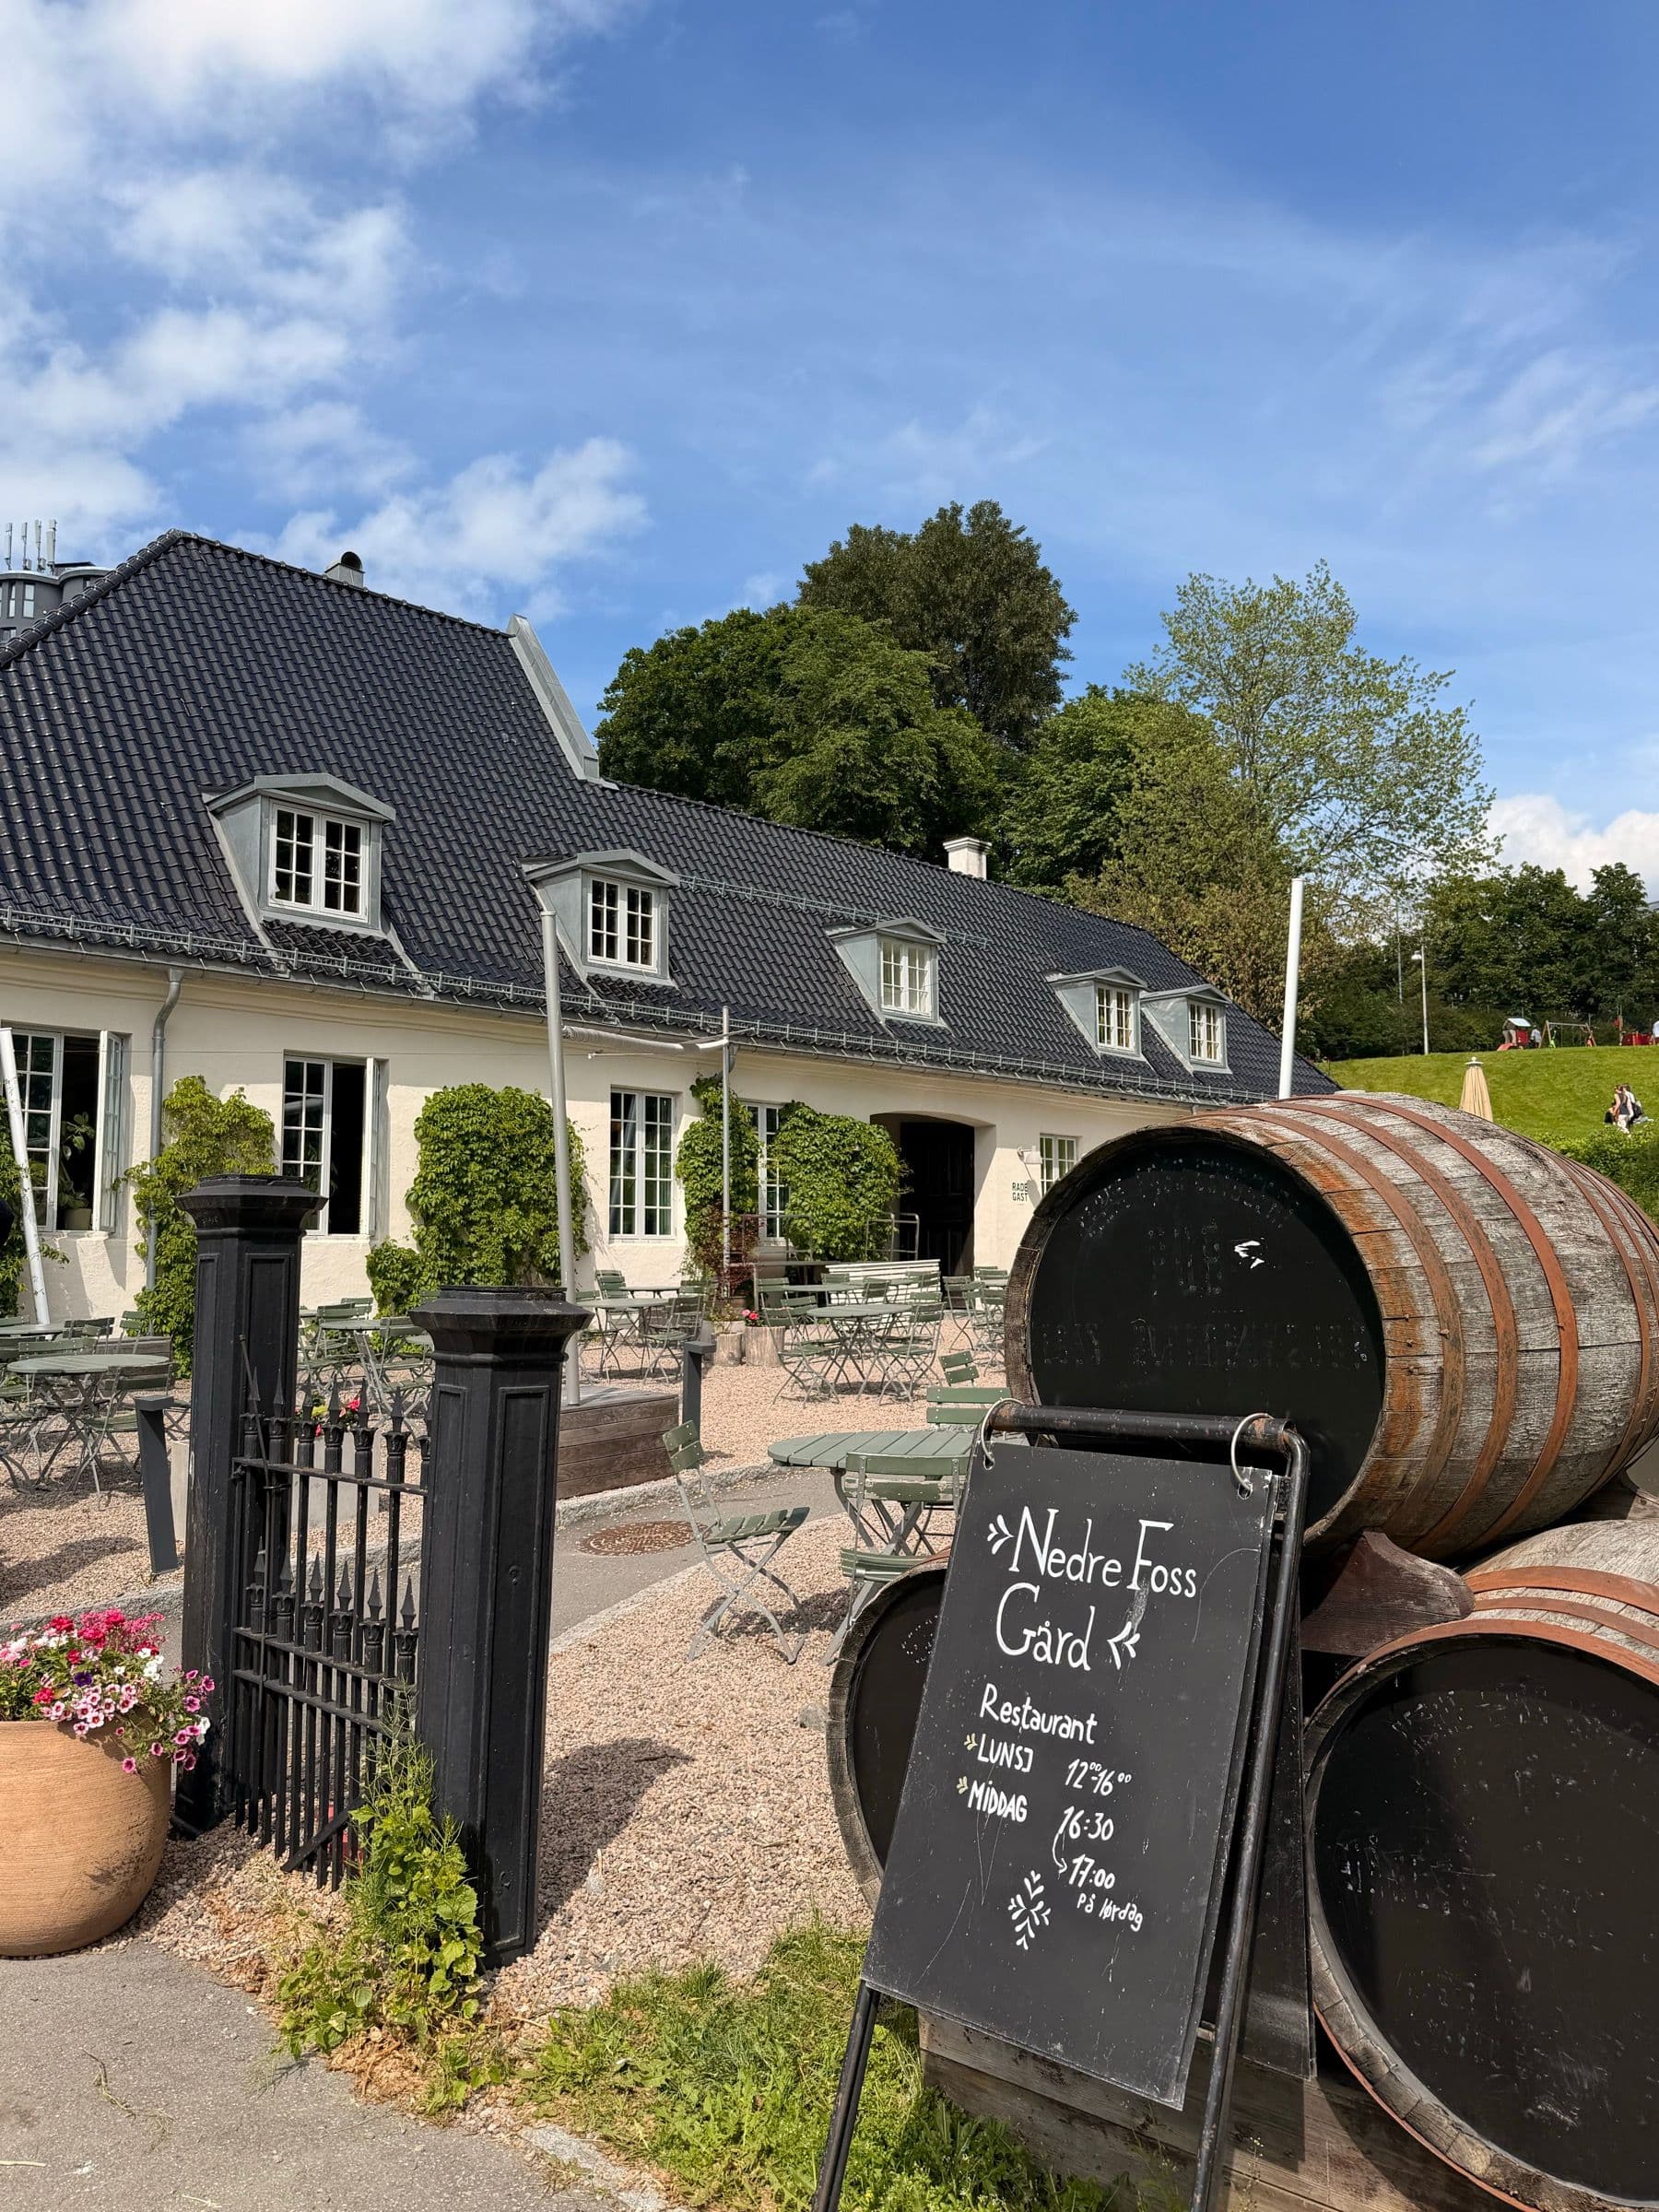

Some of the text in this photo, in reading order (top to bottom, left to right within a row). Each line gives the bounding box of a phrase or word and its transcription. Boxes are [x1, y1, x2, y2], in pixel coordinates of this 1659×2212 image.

[1012, 1182, 1028, 1192] RADE
[1012, 1192, 1028, 1202] GAST
[1008, 1506, 1196, 1598] Nedre Foss
[996, 1582, 1096, 1671] Gård
[980, 1683, 1098, 1745] Restaurant
[977, 1734, 1034, 1772] LUNSJ
[1058, 1806, 1114, 1841] 16:30
[1069, 1853, 1115, 1889] 17:00
[1099, 1899, 1143, 1932] lørdag
